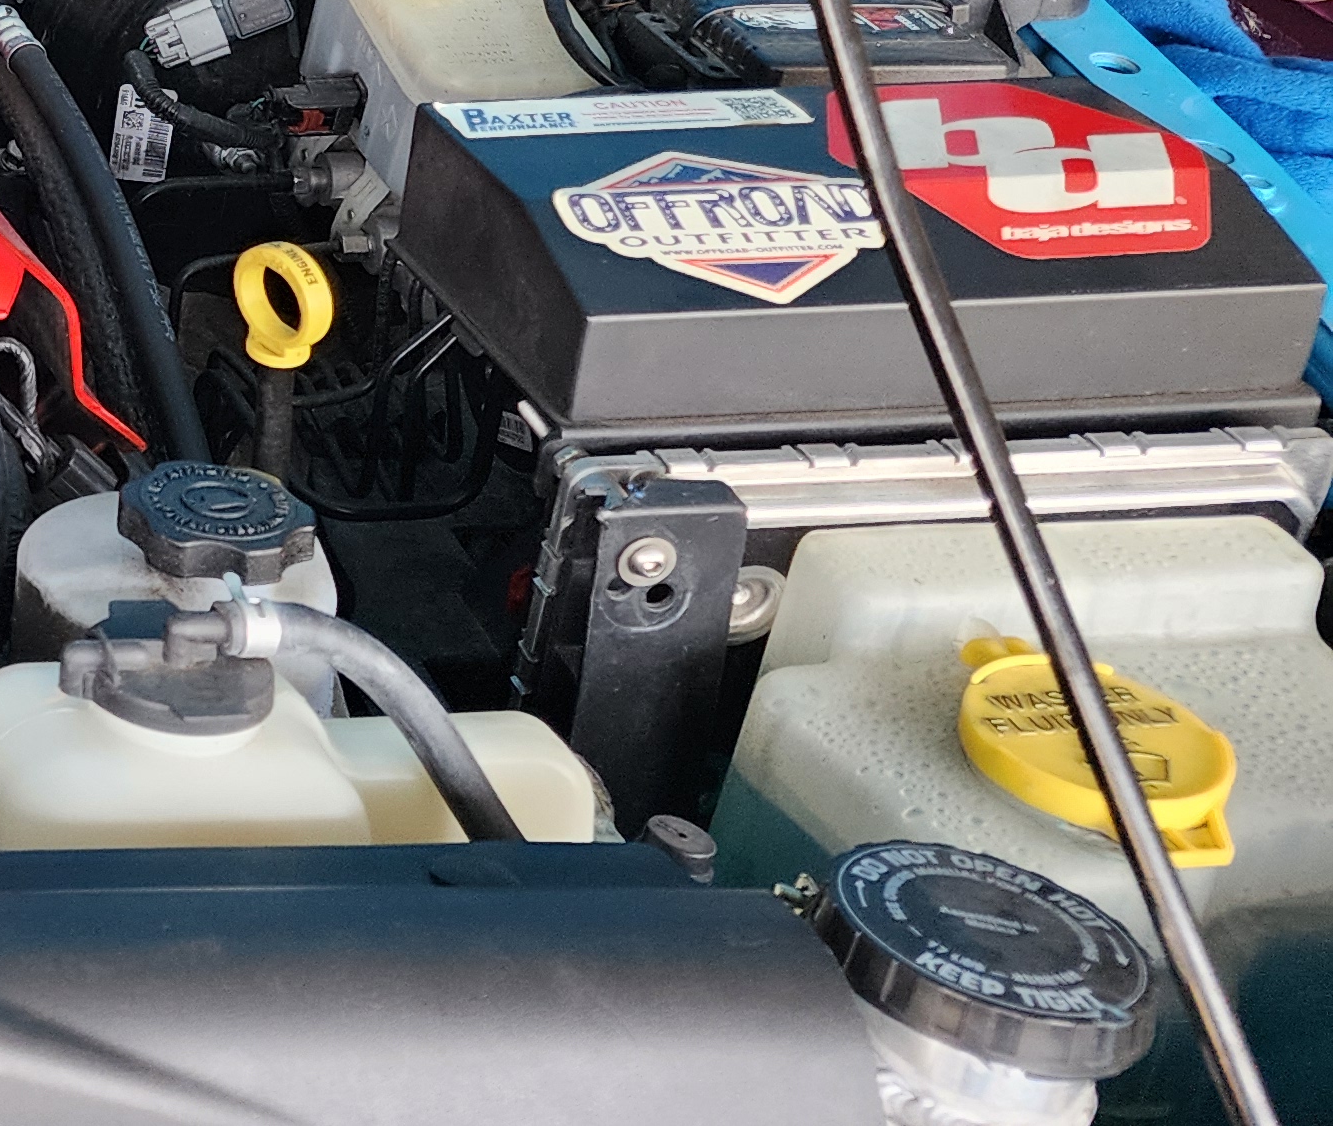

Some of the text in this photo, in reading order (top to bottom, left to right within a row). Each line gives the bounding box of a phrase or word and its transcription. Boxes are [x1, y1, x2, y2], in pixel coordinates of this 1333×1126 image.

[593, 99, 687, 110] CAUTION
[460, 108, 574, 132] BAXTER
[618, 226, 871, 249] OUTFITTER
[1001, 223, 1069, 243] baja
[986, 686, 1141, 712] WASR
[851, 857, 890, 882] DO
[880, 849, 939, 867] NOT
[950, 854, 1043, 892] OPEN
[1048, 892, 1112, 931] HOT
[916, 951, 1006, 996] KEEP
[1011, 984, 1105, 1011] TIGHT
